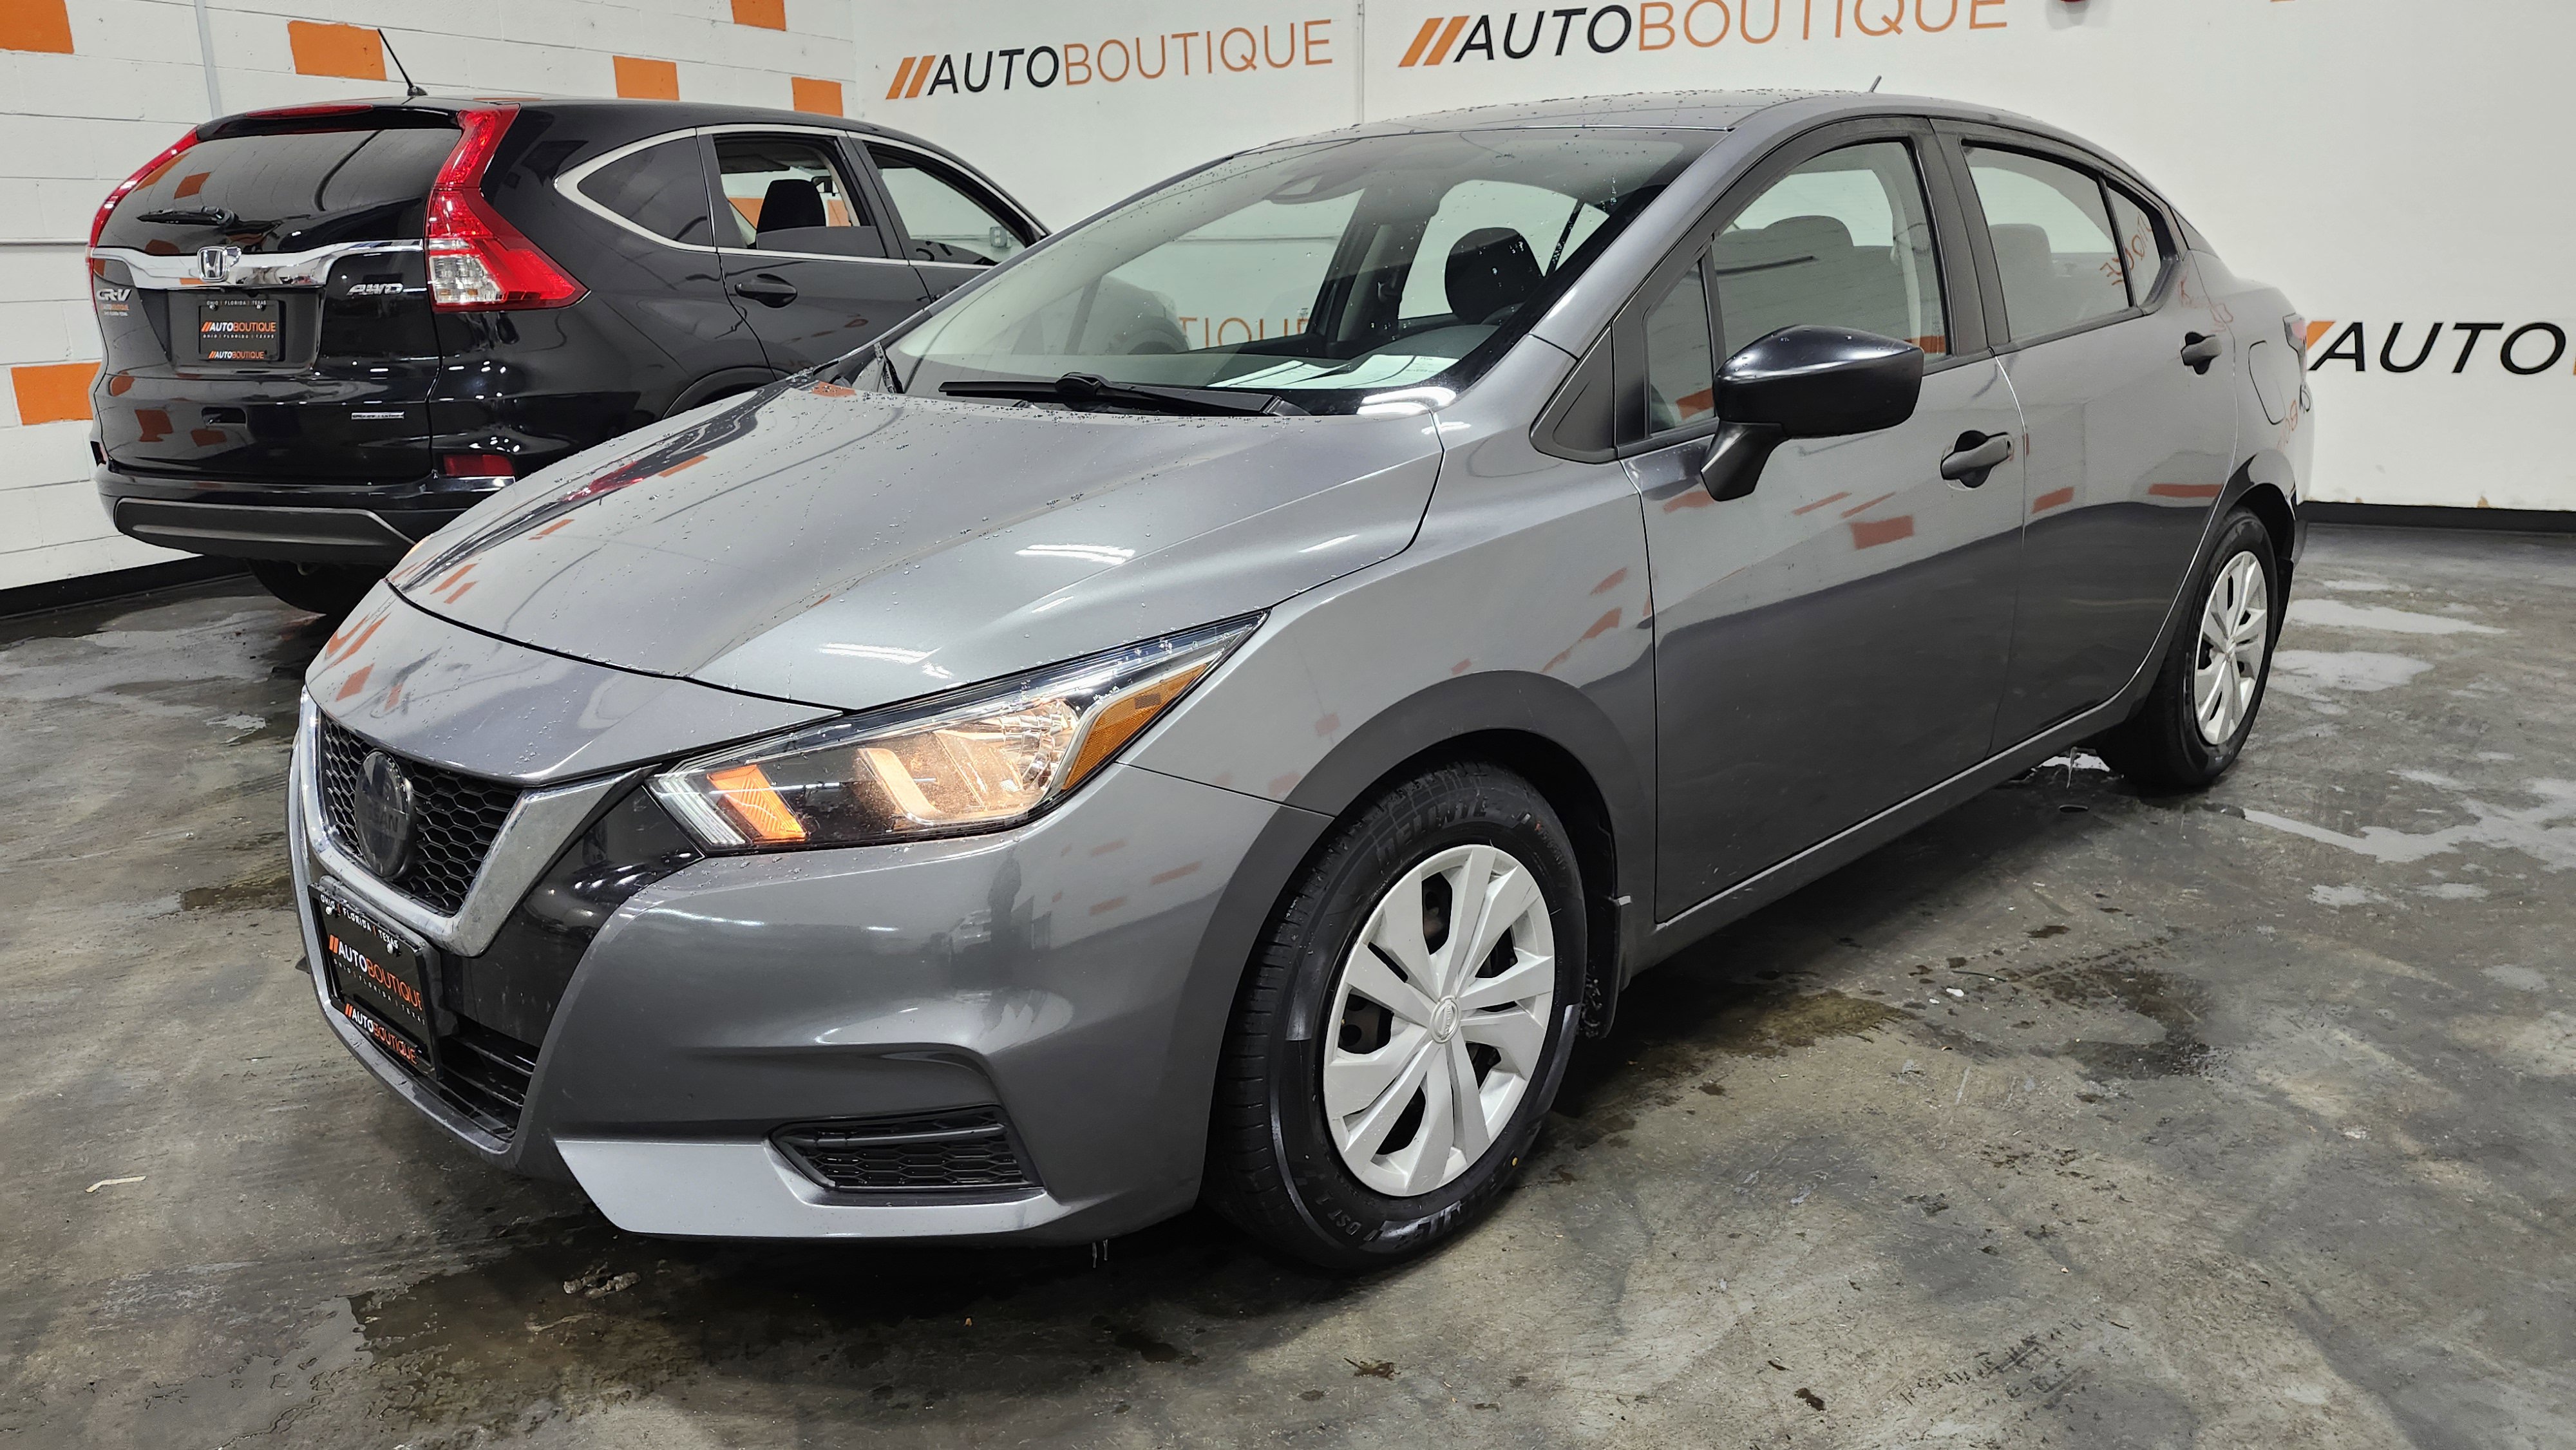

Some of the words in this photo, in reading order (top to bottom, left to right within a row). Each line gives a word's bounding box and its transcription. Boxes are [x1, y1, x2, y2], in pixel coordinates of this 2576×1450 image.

[927, 19, 1333, 96] AUTOBOUTIQUE
[96, 288, 131, 301] CR-V
[346, 283, 403, 296] AWD
[209, 322, 276, 332] AUTOBOUTIQUE
[214, 351, 265, 359] AUTOBOUTIQUE
[2307, 321, 2576, 375] AUTO
[320, 894, 336, 910] OHIO
[342, 907, 372, 933] FLORIDA
[378, 929, 399, 950] TEXAS
[338, 941, 423, 1012] AUTOBOUTIQUE
[359, 975, 392, 1002] FLORIDA
[352, 1008, 417, 1065] AUTOBOUTIQUE
